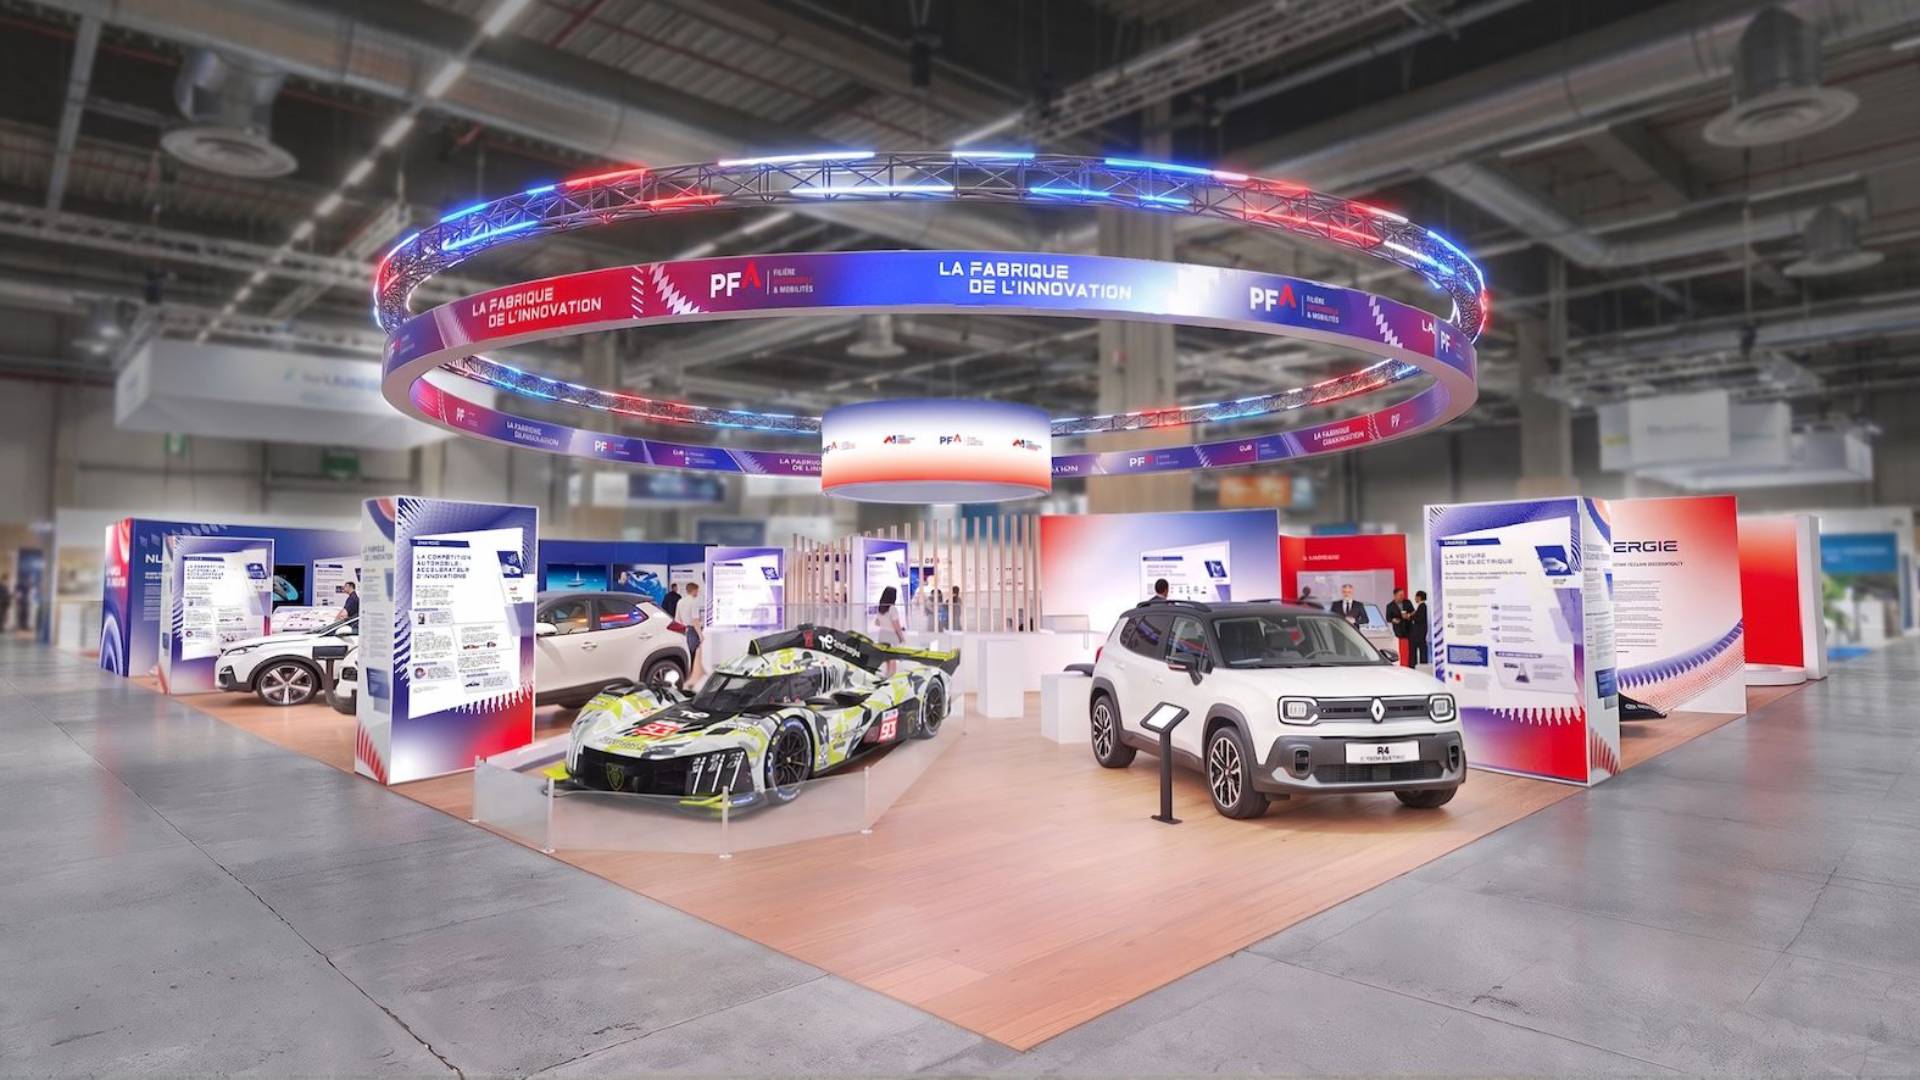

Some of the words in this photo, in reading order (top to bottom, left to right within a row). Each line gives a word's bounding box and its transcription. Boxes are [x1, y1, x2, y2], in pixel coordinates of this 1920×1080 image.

[710, 260, 762, 298] PFA
[939, 261, 965, 276] LA
[970, 261, 1069, 279] FABRIQUE
[969, 279, 996, 295] DE
[1002, 280, 1132, 300] L'INNOVATION
[1250, 283, 1297, 312] PFA
[472, 302, 486, 317] LA
[489, 287, 554, 312] FABRIQUE
[488, 312, 504, 329] DE
[508, 297, 602, 325] L'INNOVATION
[939, 433, 962, 445] PFA
[1613, 540, 1678, 553] ERGIE
[1377, 746, 1390, 755] R4
